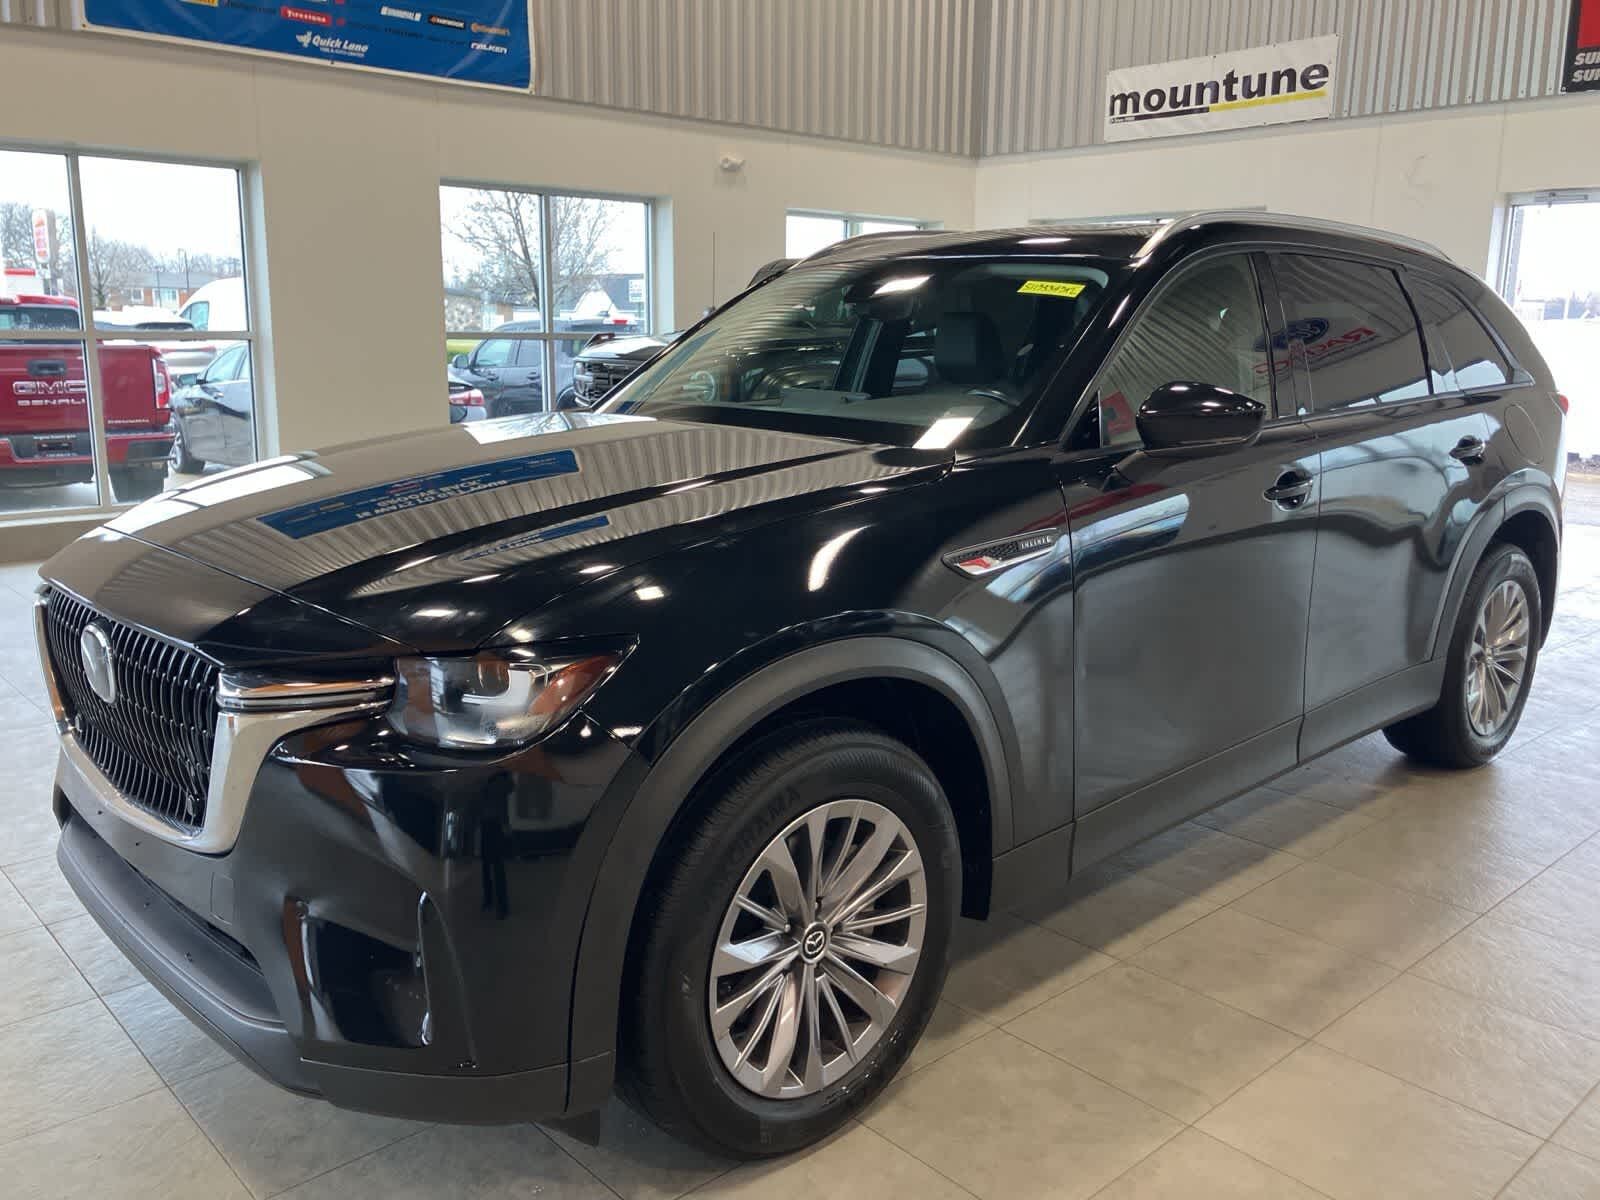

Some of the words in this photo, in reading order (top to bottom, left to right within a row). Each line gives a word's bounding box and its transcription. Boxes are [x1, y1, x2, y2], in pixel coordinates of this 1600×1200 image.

[312, 34, 342, 48] Quick
[342, 40, 369, 53] Lane
[1109, 63, 1329, 116] mountune
[13, 380, 87, 395] GMC
